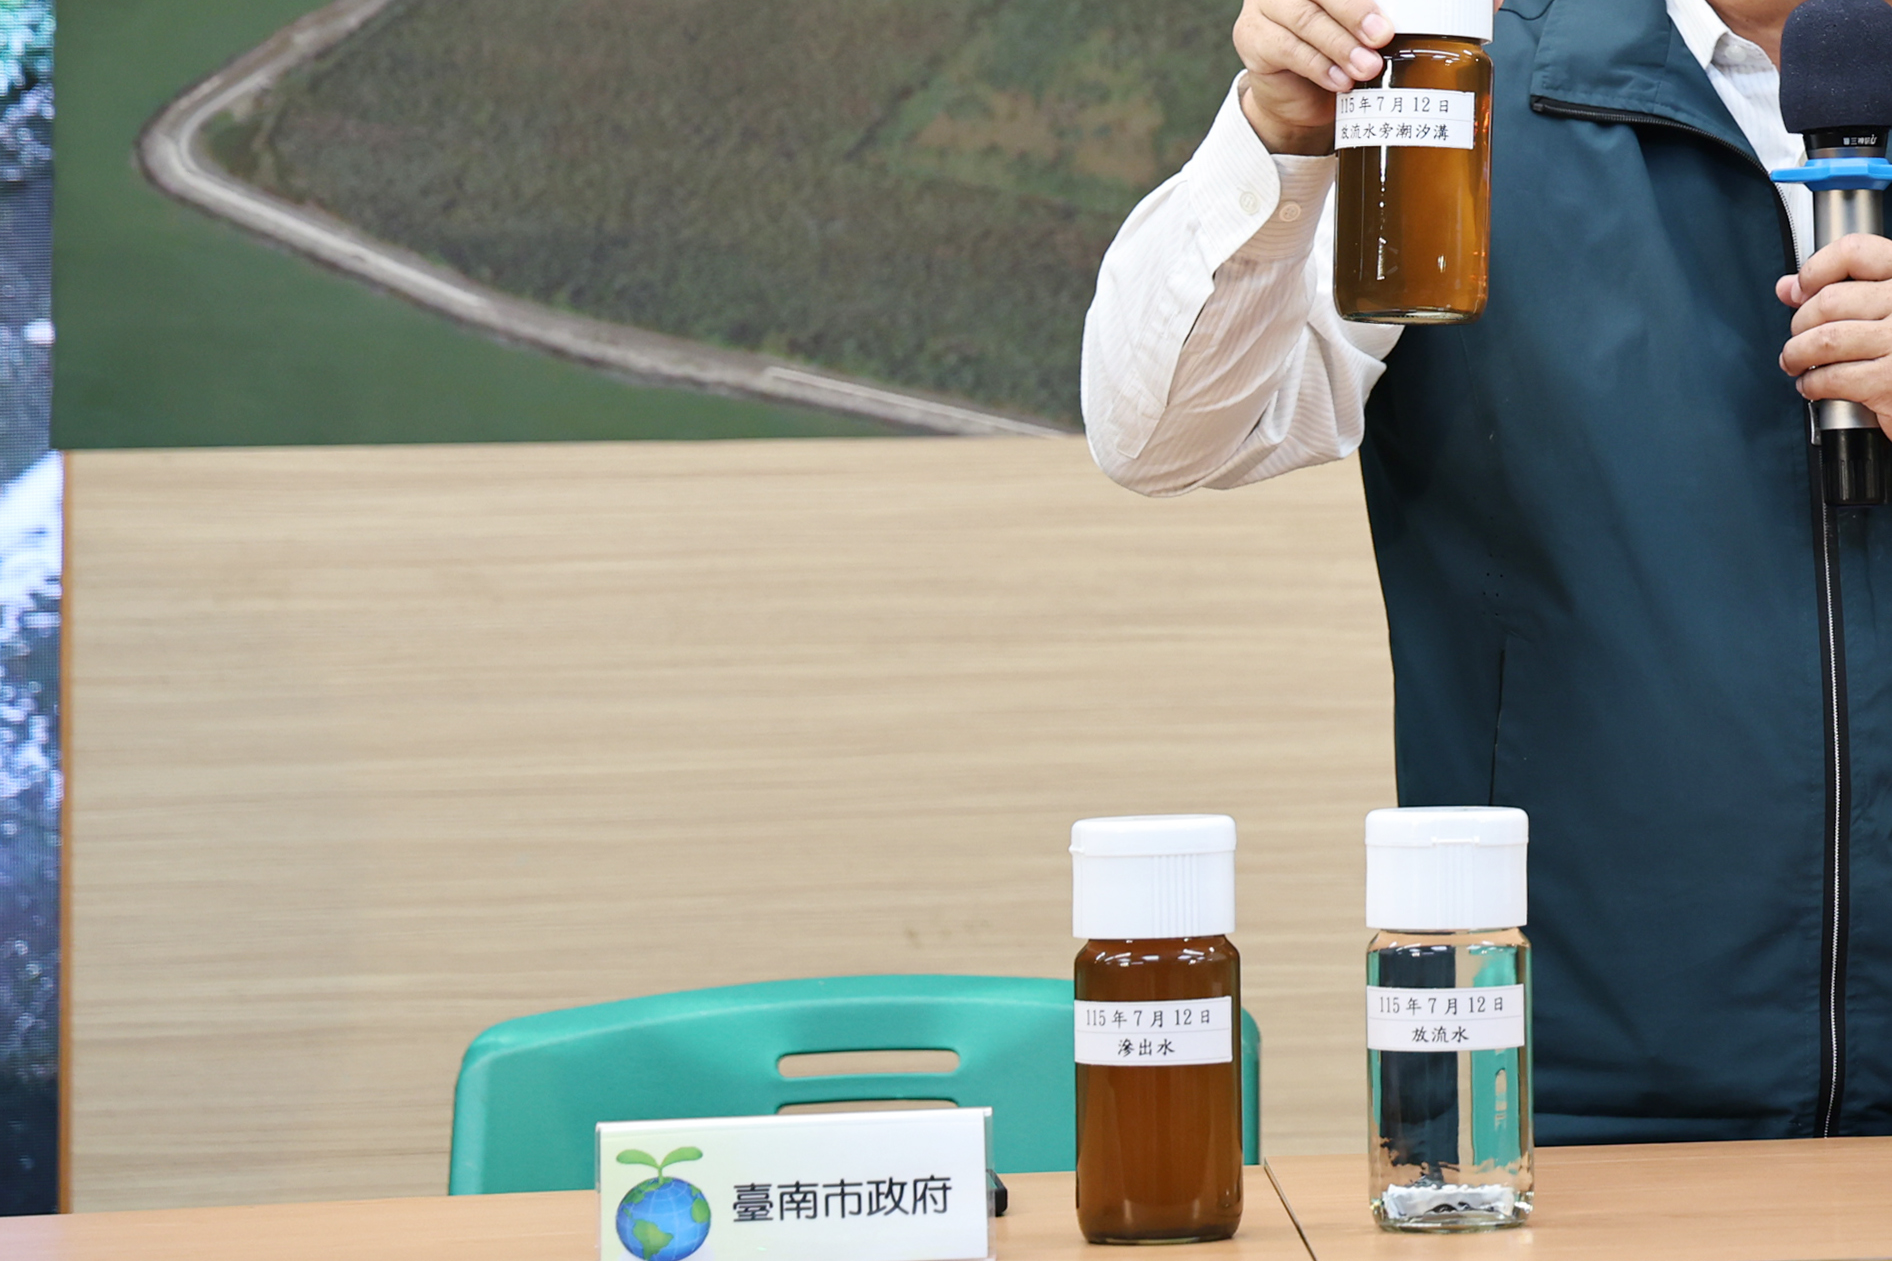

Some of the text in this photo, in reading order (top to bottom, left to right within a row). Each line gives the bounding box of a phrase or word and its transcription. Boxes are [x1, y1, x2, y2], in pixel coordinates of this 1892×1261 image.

[1411, 1025, 1470, 1044] 放流水
[1117, 1037, 1176, 1057] 滲出水
[732, 1174, 953, 1223] 臺南市政府
